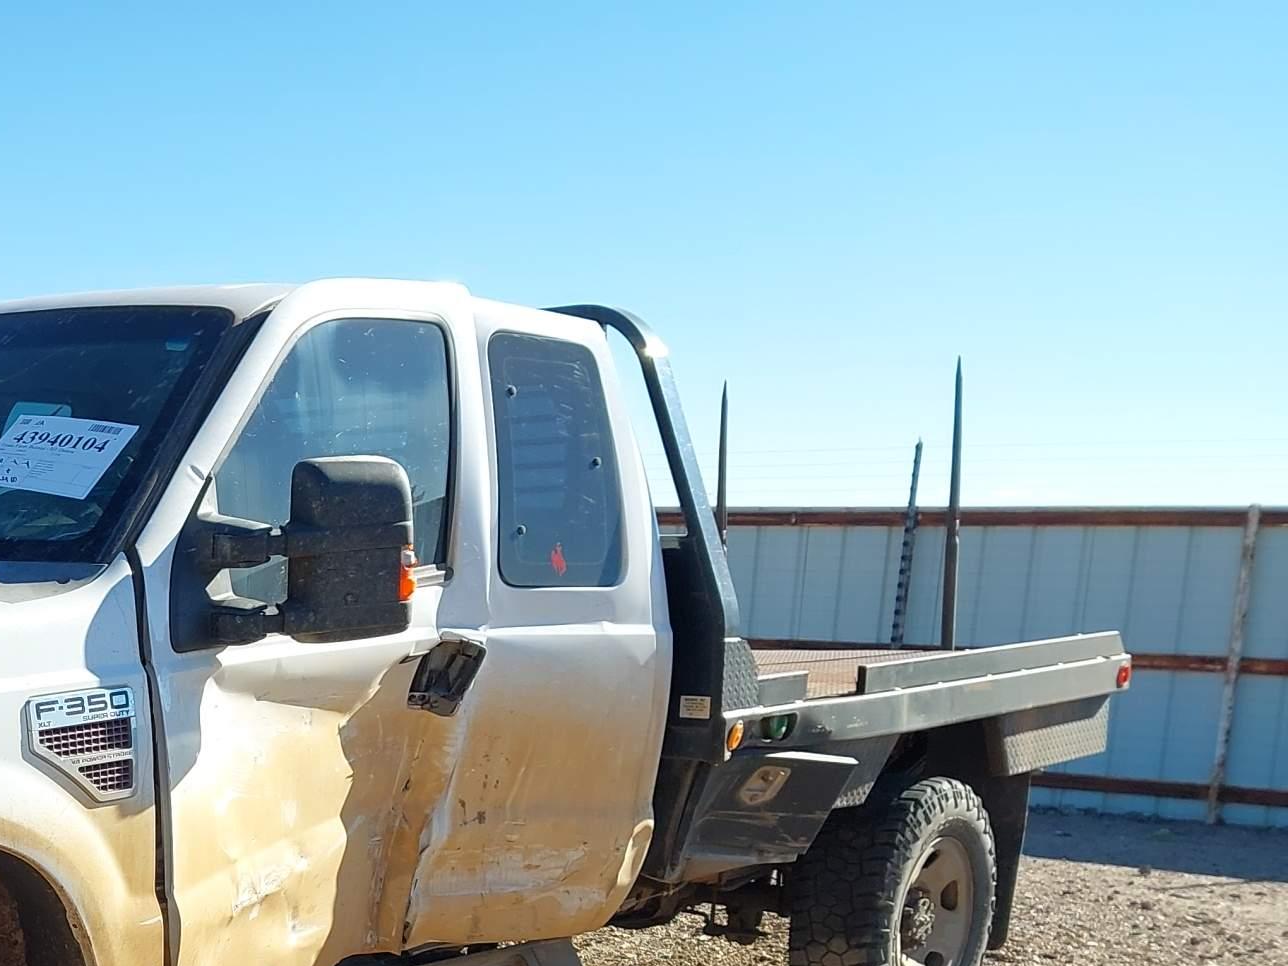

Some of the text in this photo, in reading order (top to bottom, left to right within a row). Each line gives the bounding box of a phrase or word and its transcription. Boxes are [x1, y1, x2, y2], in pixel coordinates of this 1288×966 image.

[13, 430, 110, 453] 43940104
[35, 690, 129, 721] F-350
[82, 709, 130, 721] SUPER DUTY
[38, 720, 52, 729] XLT
[81, 754, 107, 763] POWER
